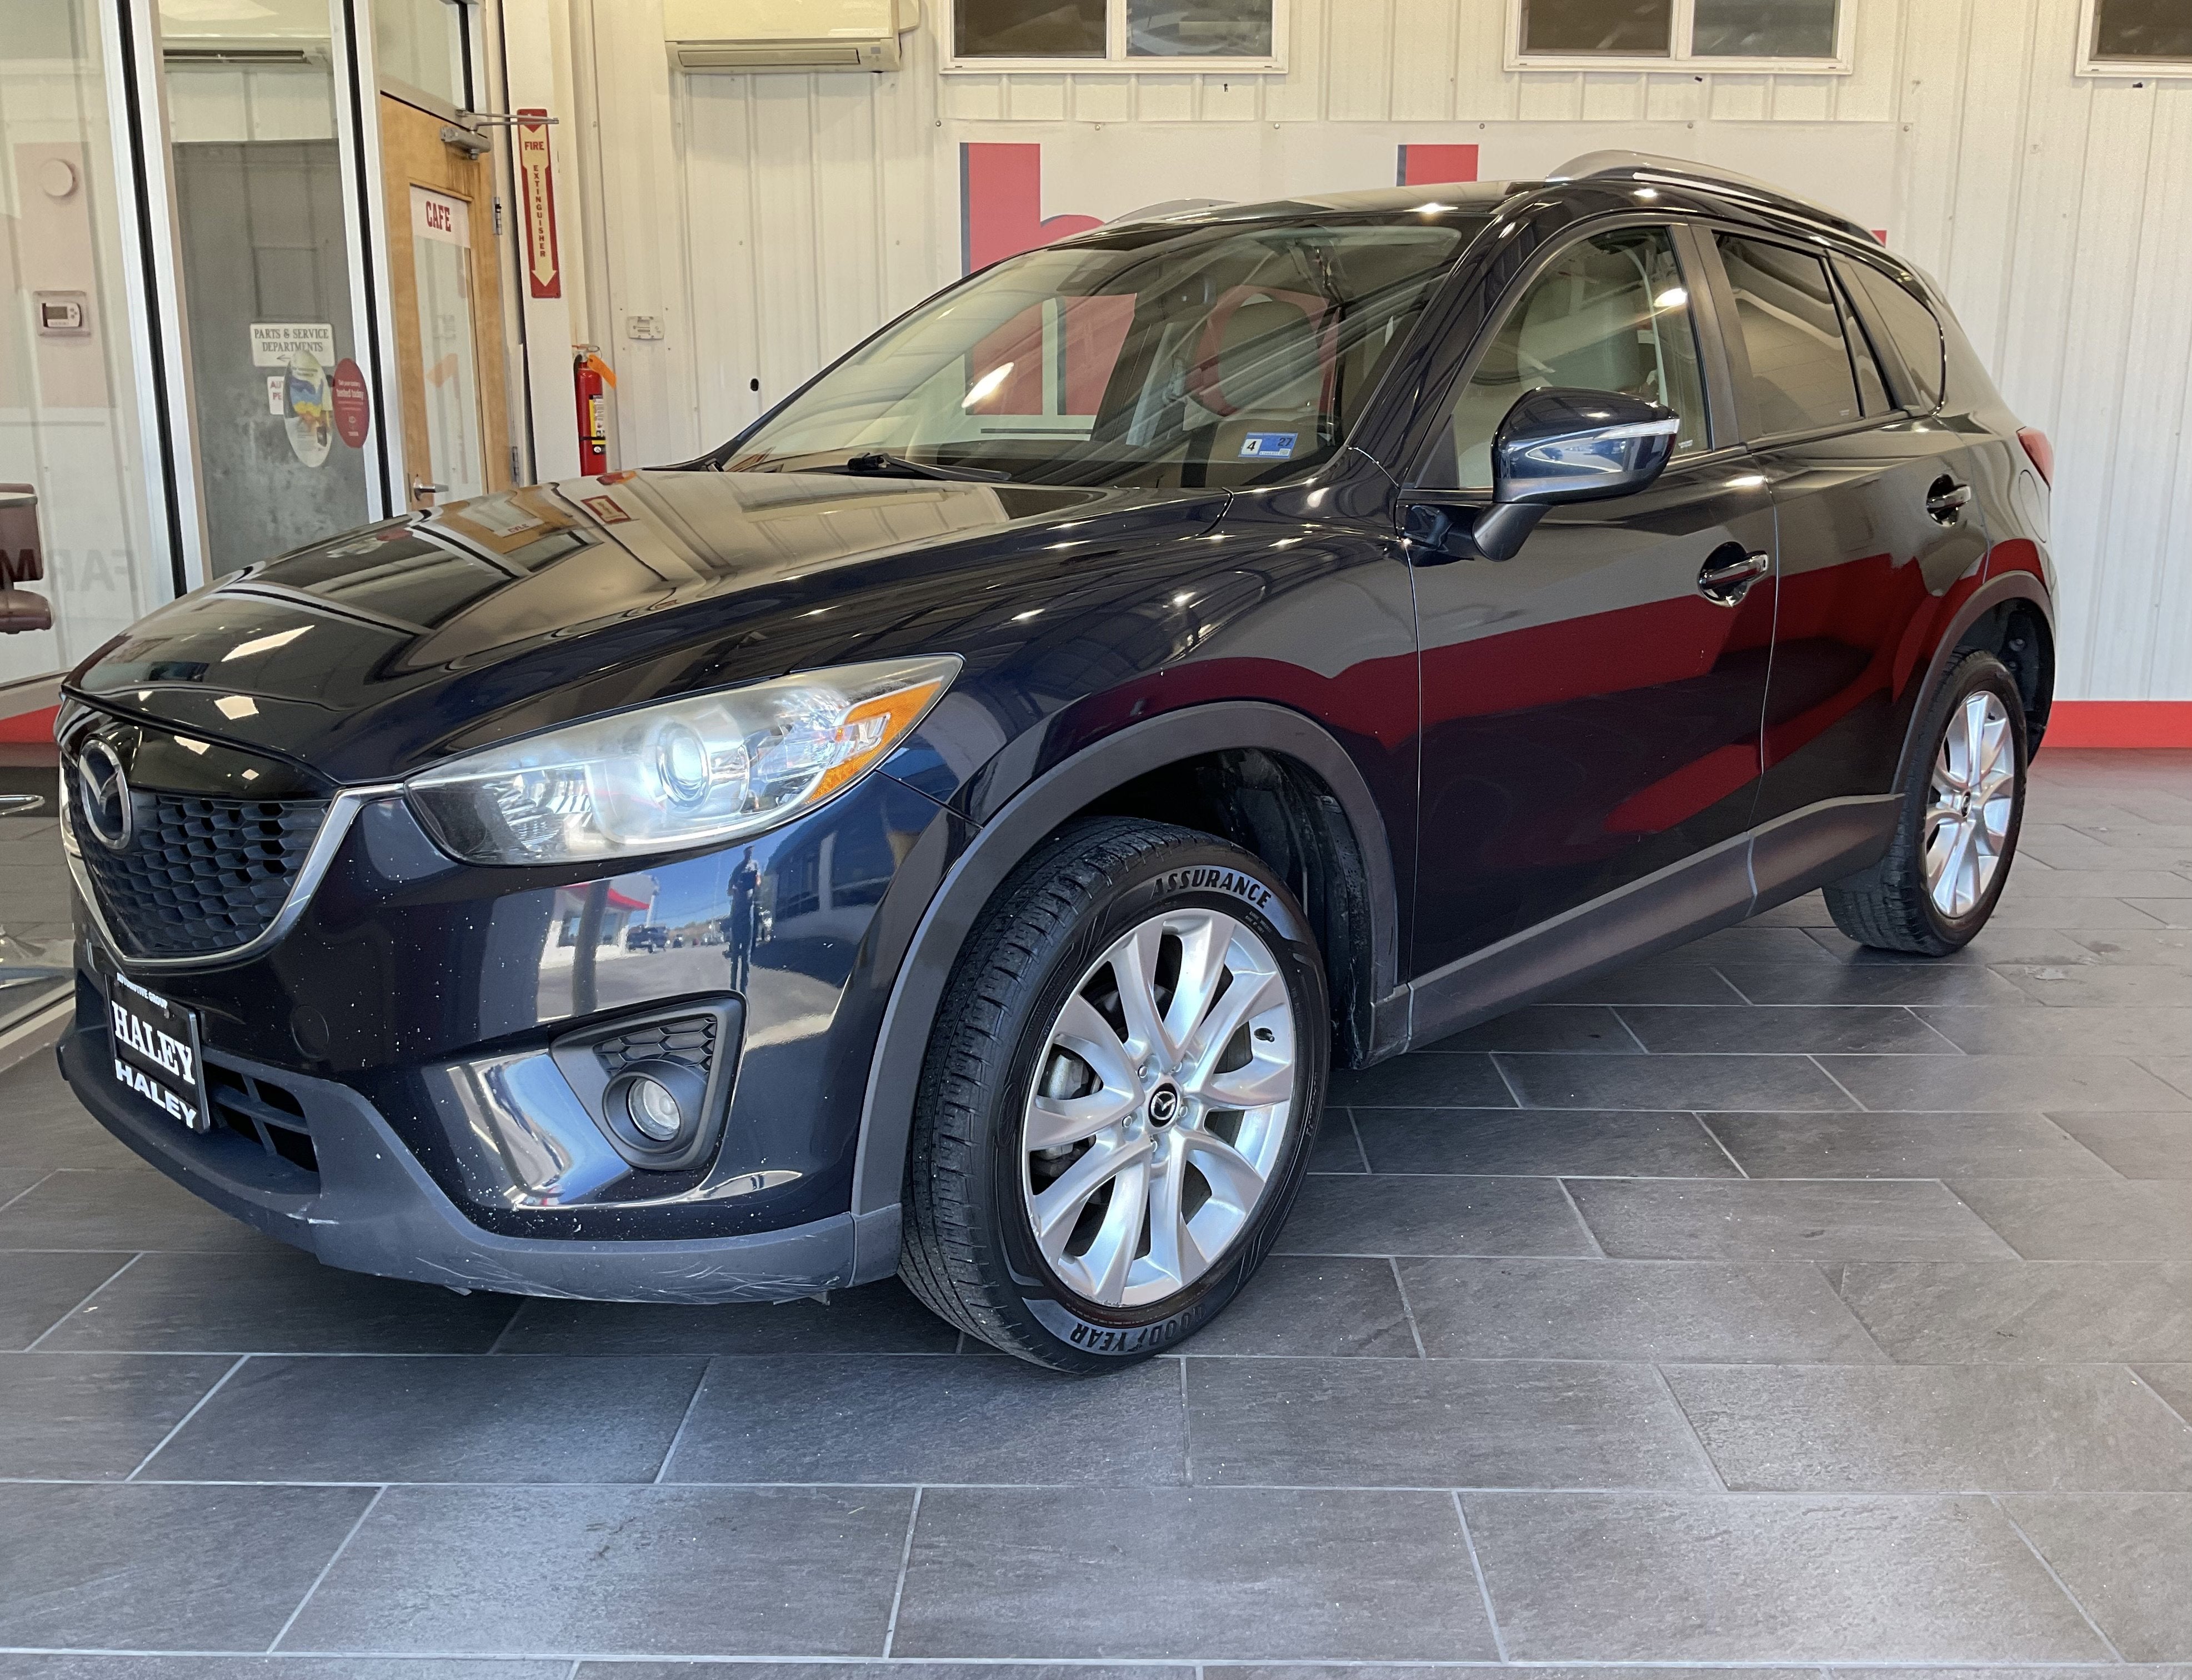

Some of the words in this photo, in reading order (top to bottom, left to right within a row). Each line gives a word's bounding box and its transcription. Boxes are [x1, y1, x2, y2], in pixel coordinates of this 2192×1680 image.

[524, 141, 545, 151] FIRE
[426, 201, 452, 232] CAFE
[533, 164, 546, 257] EXTINGUISHER
[254, 328, 281, 339] PARTS
[283, 328, 290, 338] &
[293, 328, 329, 339] SERVICE
[262, 342, 323, 352] DEPARTMENTS
[1247, 441, 1257, 451] 4
[1278, 437, 1293, 447] 27
[1150, 869, 1272, 909] ASSURANCE
[117, 972, 149, 999] AUTOMOTIVE
[148, 991, 168, 1009] GROUP
[112, 1000, 196, 1085] HALEY
[114, 1059, 197, 1129] HALEY
